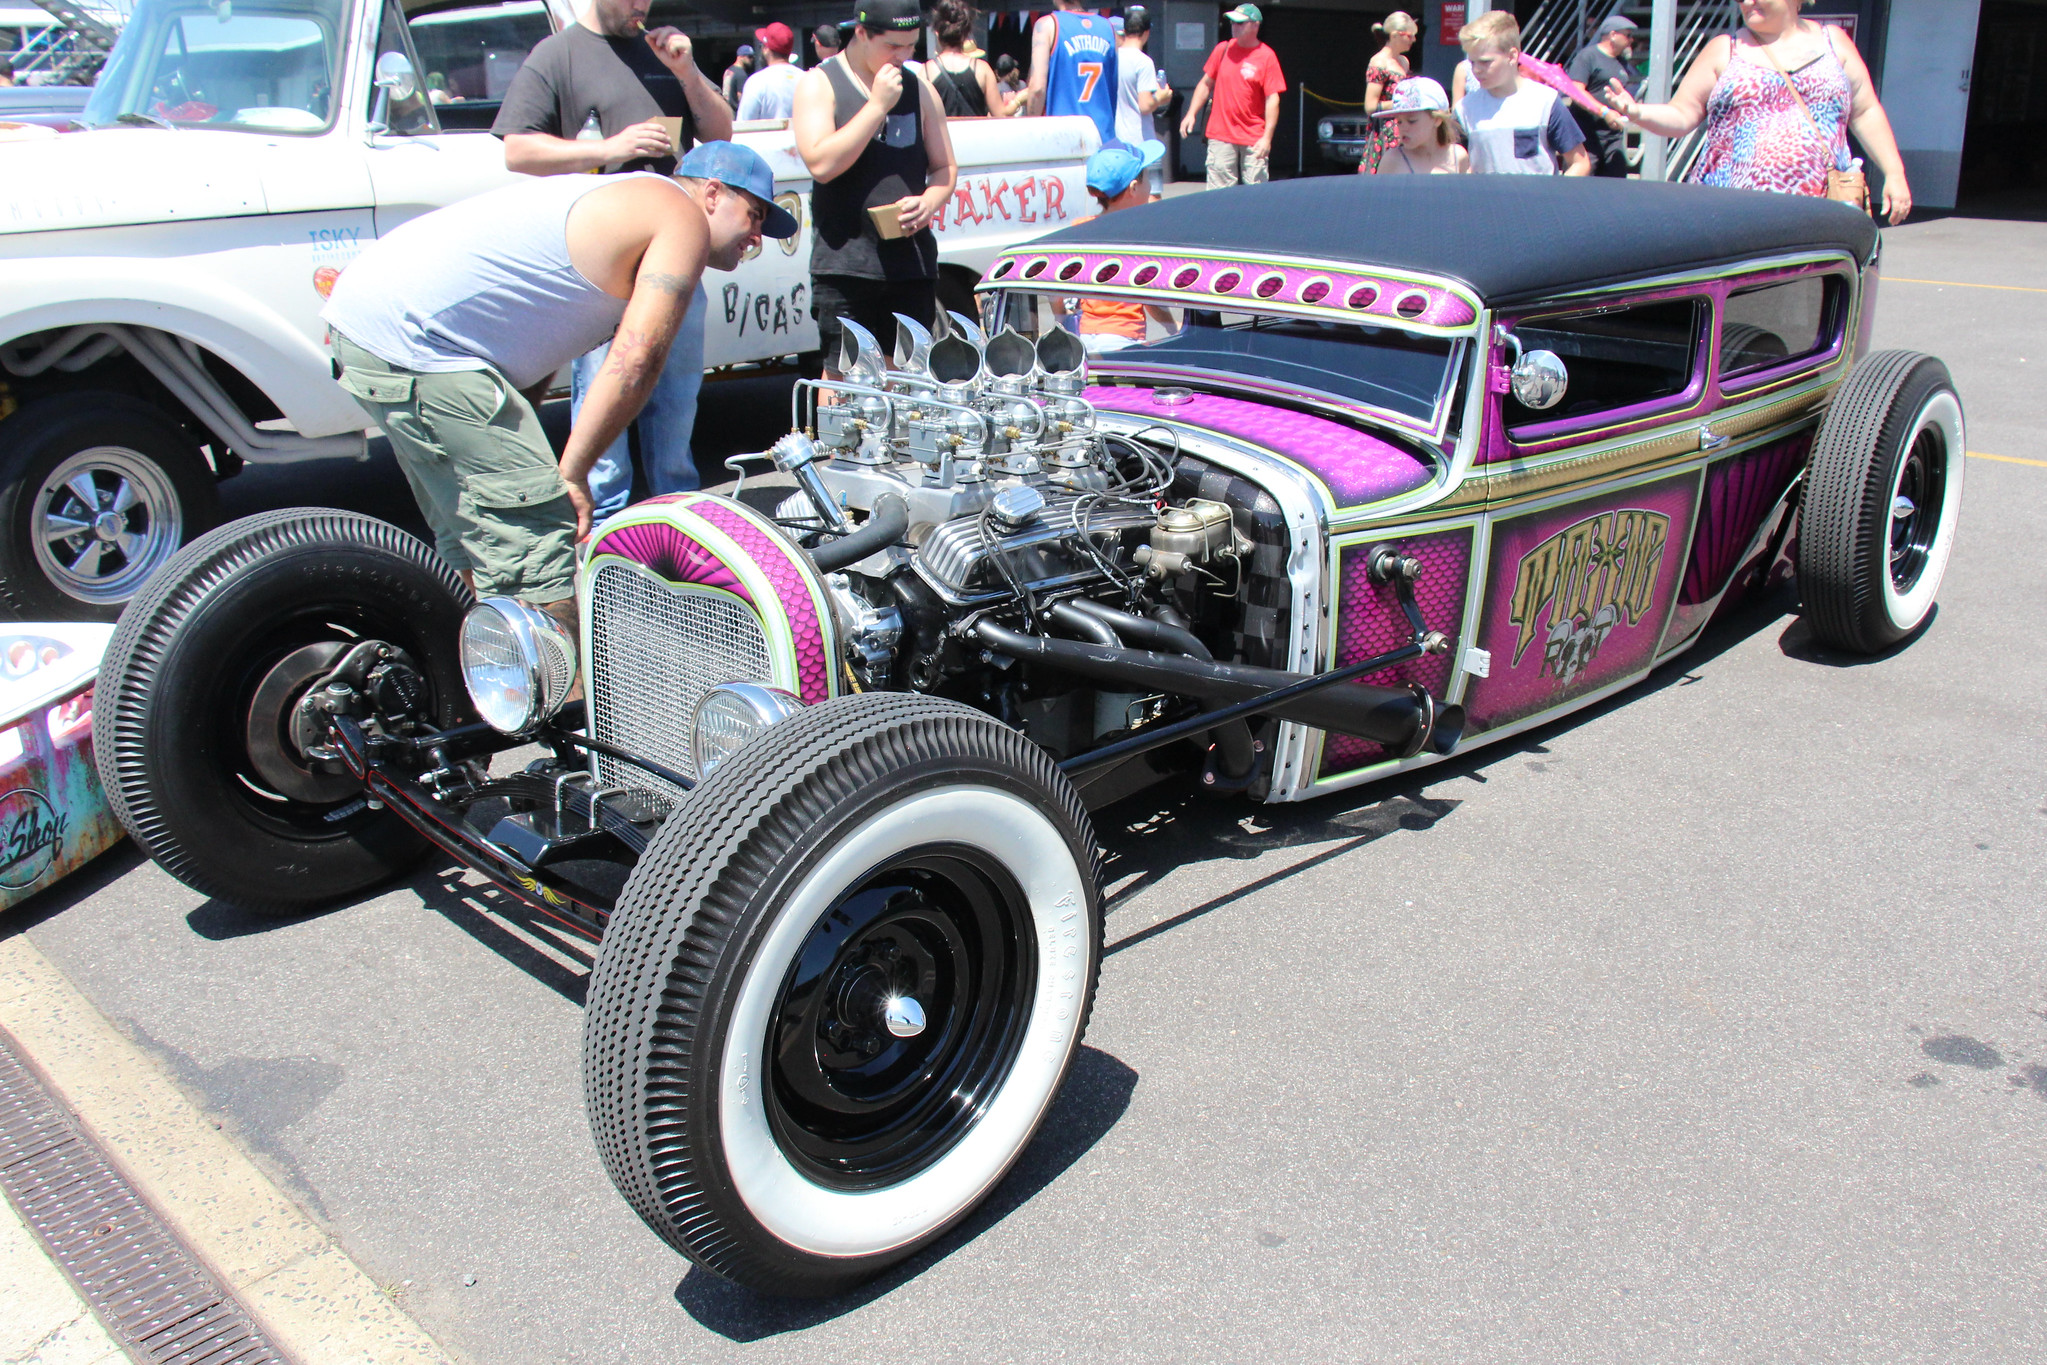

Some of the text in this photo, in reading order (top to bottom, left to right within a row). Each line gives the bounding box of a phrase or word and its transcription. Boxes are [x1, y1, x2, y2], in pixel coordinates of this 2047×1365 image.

[1064, 35, 1111, 57] ANTHONY
[1078, 62, 1103, 103] 7
[309, 226, 360, 251] ISKY
[1041, 889, 1079, 1066] Firestone
